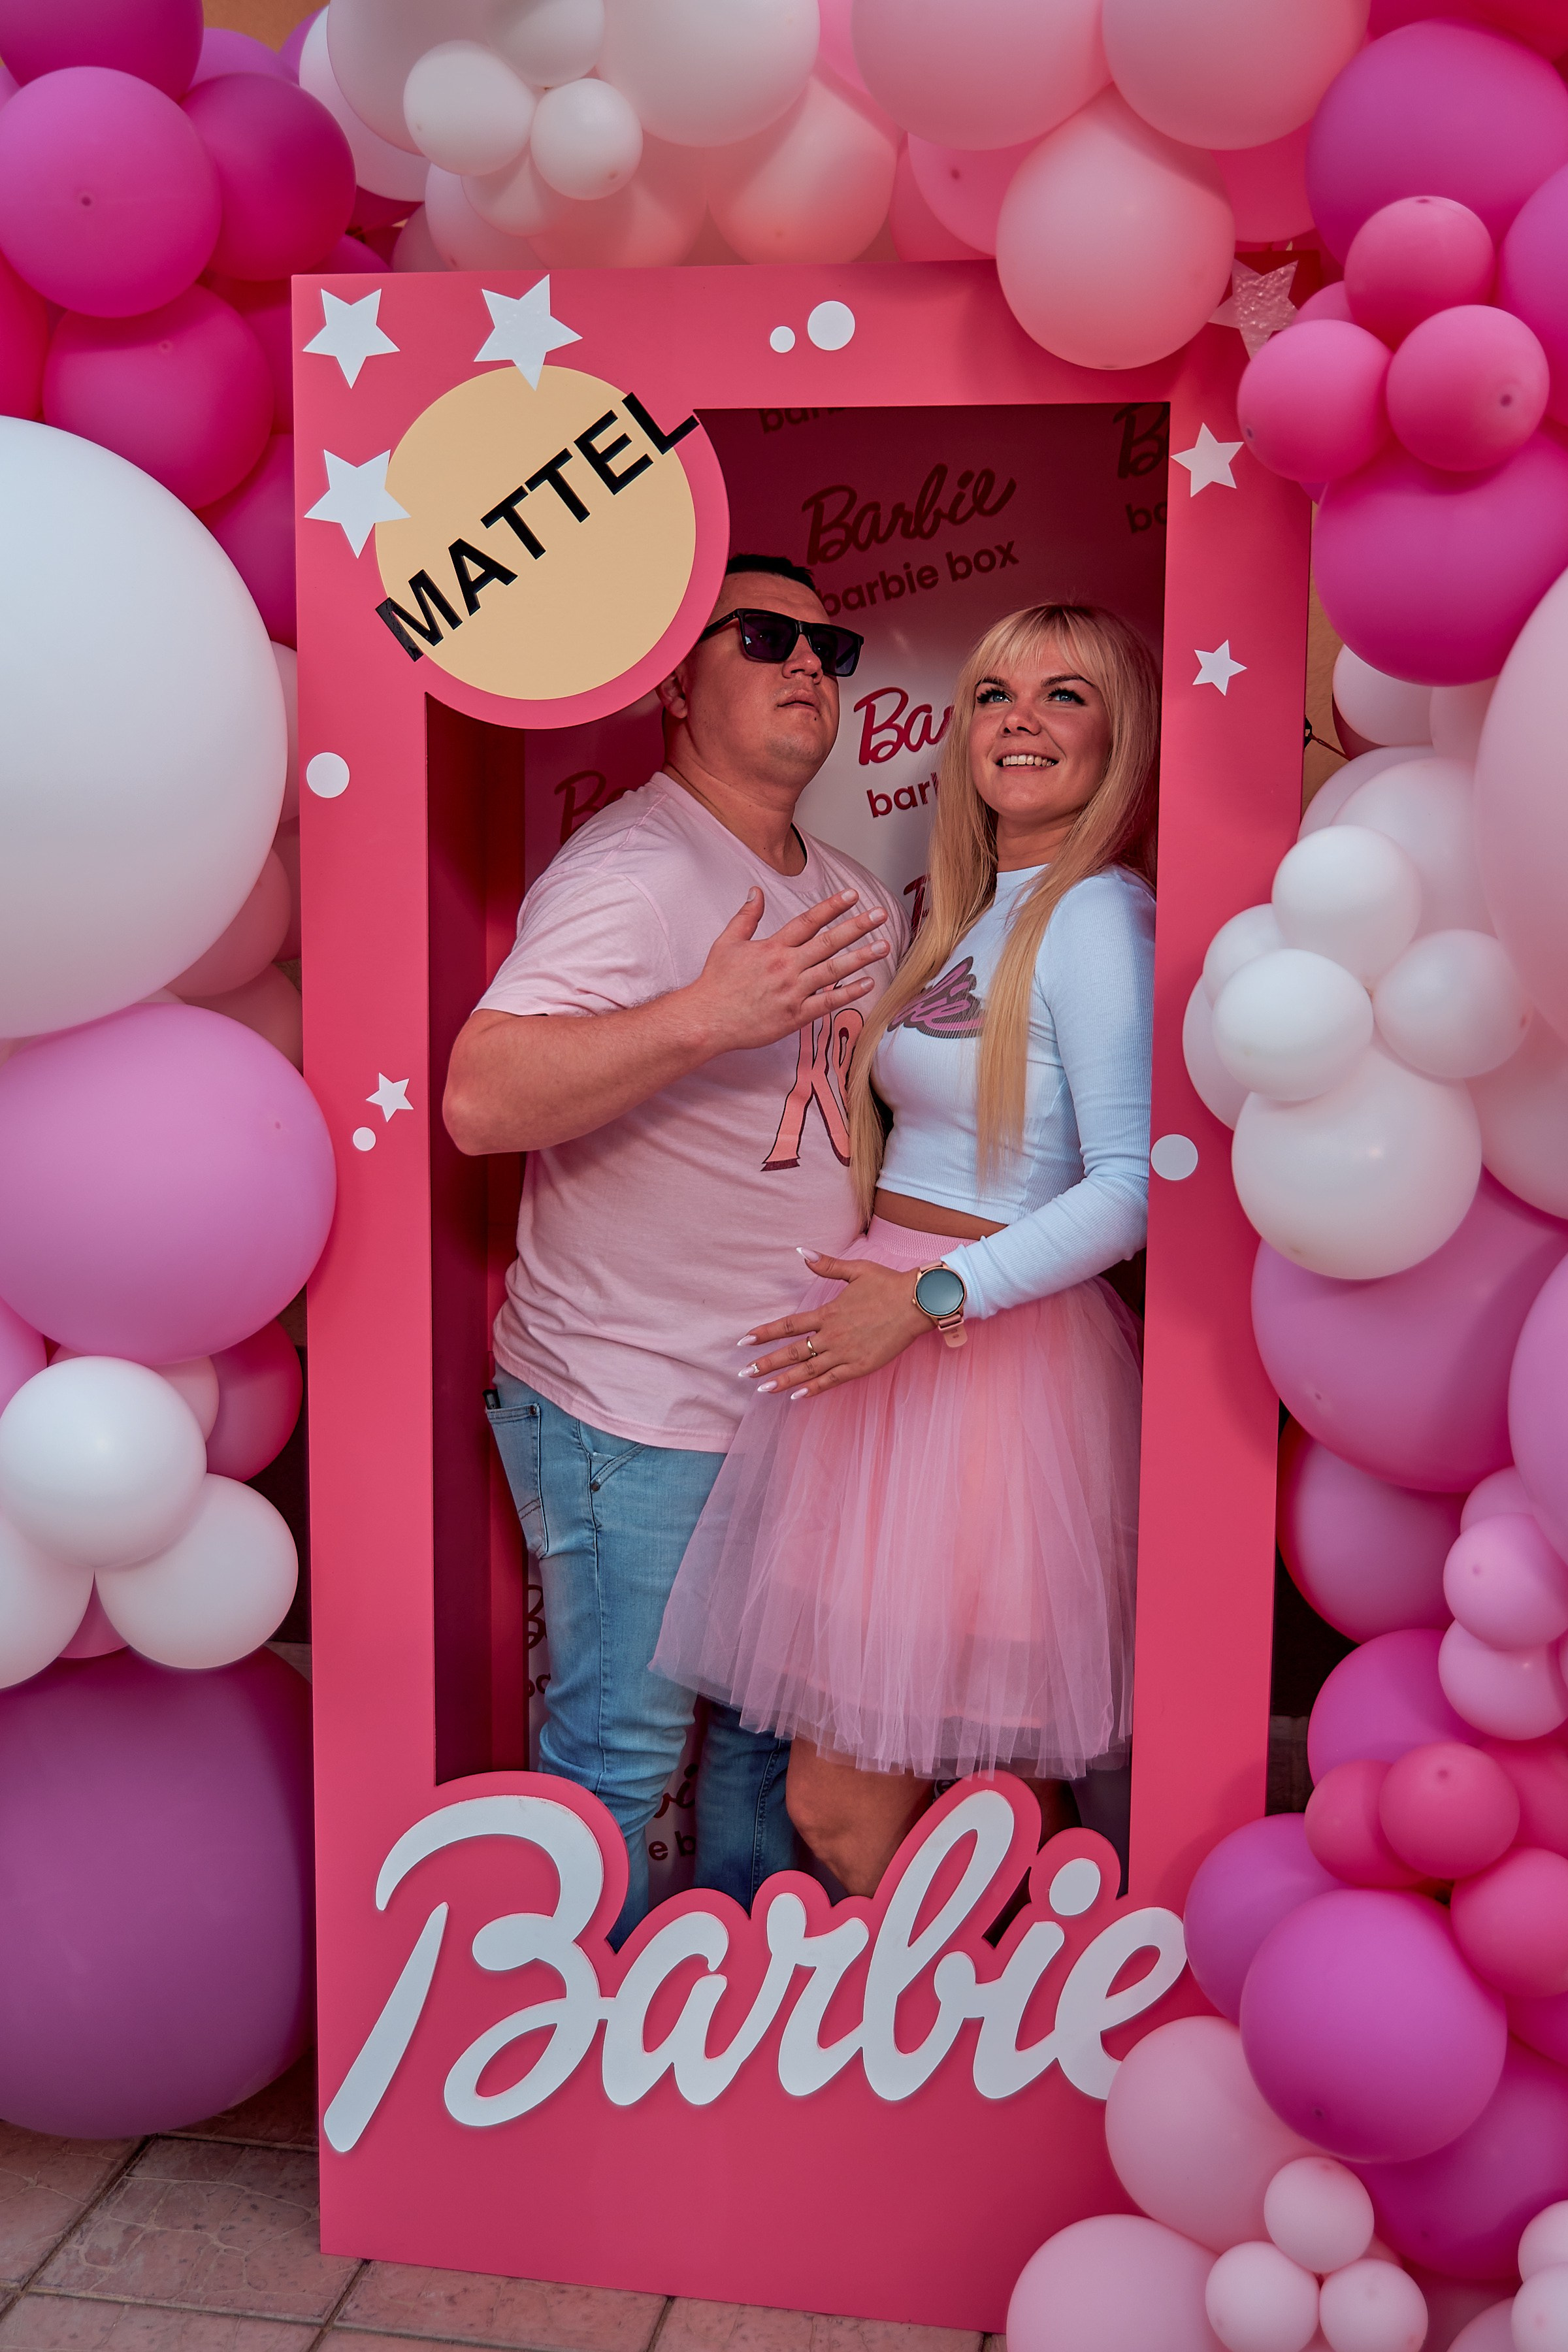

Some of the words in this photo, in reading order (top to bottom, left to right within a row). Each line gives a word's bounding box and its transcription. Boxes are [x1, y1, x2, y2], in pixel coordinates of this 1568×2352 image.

[376, 392, 699, 662] MATTEL
[801, 463, 1017, 566] Barbie
[815, 562, 939, 617] barbie
[945, 540, 1020, 584] box
[866, 772, 939, 818] bar
[324, 1789, 1186, 2152] Barbie
